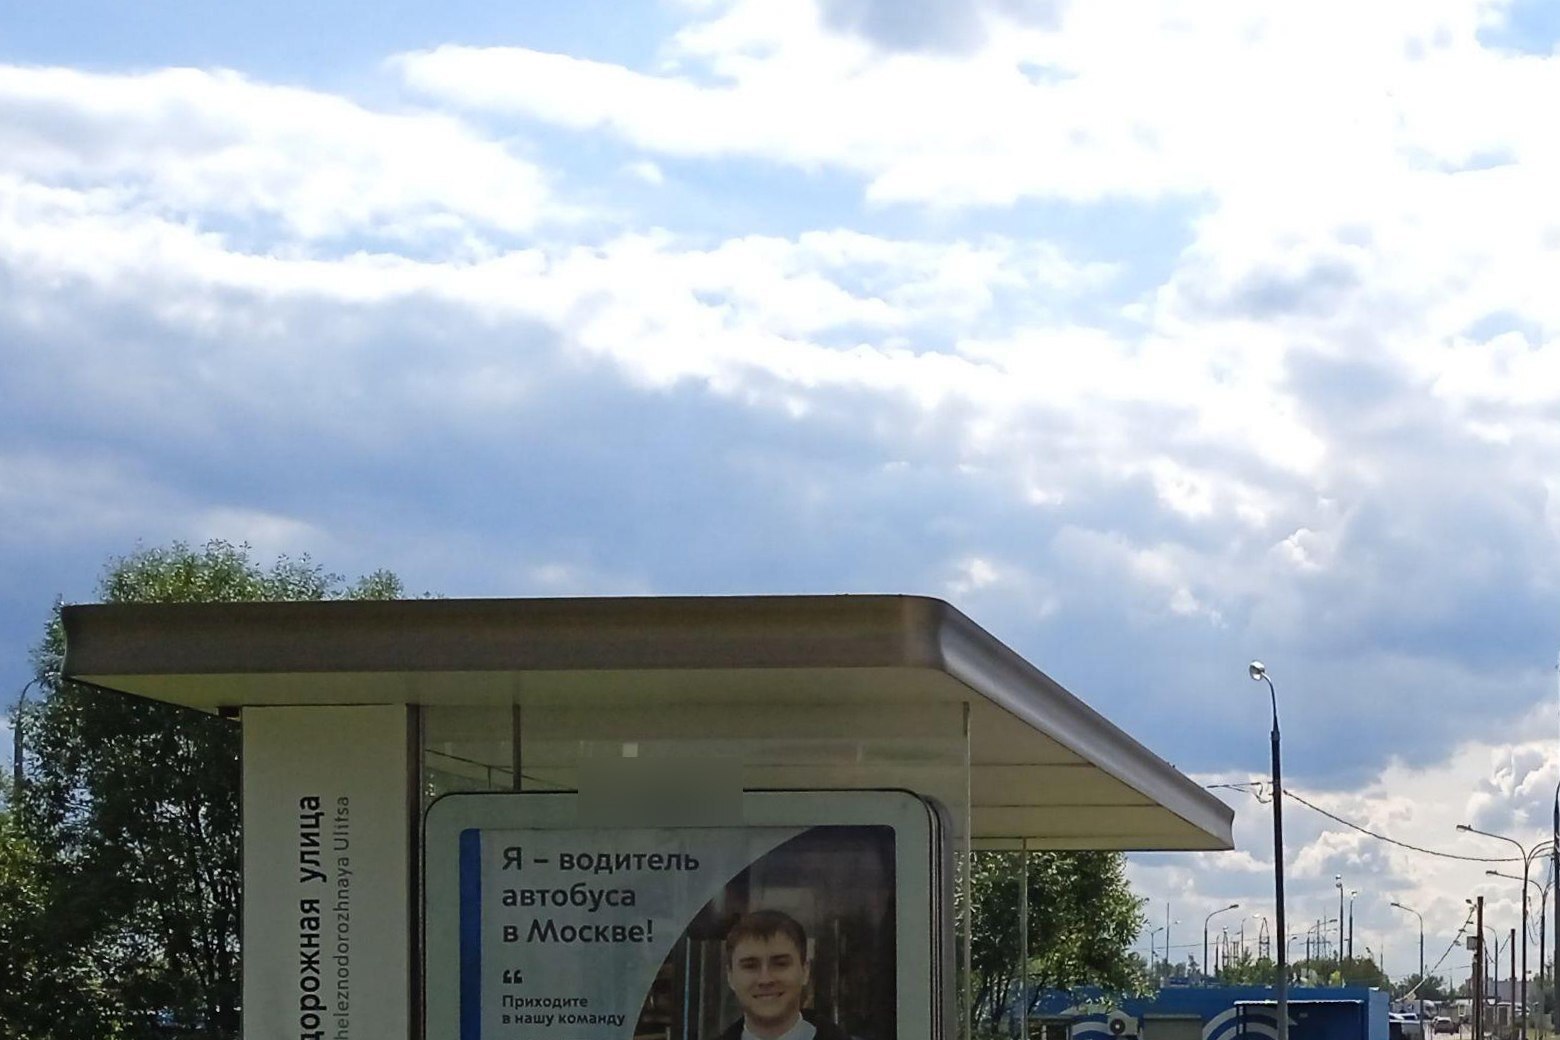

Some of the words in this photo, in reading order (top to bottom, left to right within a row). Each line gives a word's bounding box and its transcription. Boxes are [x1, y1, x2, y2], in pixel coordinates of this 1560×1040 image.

[332, 796, 350, 851] Ulitsa
[299, 795, 327, 883] улица
[502, 847, 522, 871] Я
[559, 852, 700, 874] водитель
[502, 882, 636, 912] автобуса
[503, 925, 518, 943] в
[527, 919, 654, 943] Москве!
[502, 995, 589, 1010] Приходите
[502, 1014, 511, 1024] в
[515, 1014, 555, 1027] нашу
[558, 1014, 626, 1027] команду
